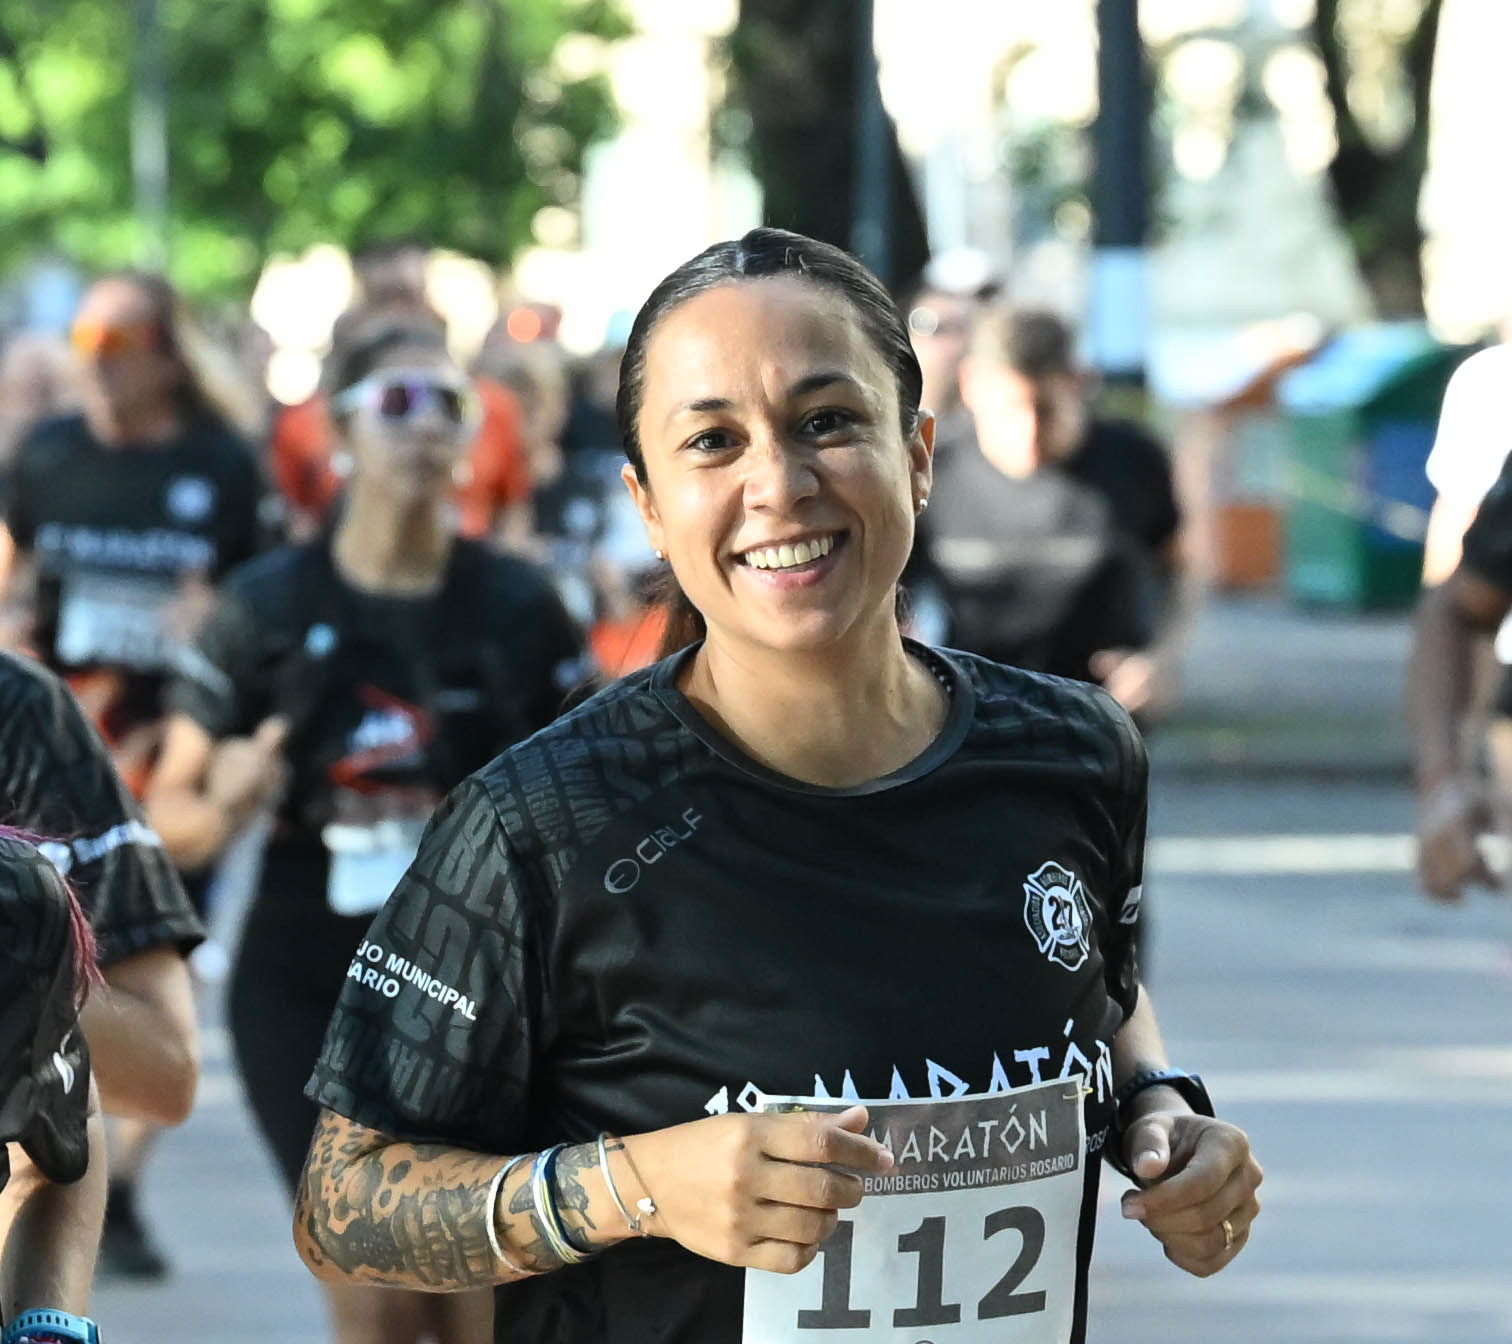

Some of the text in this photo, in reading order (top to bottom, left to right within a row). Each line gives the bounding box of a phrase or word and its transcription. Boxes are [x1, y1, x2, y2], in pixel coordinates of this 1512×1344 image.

[347, 959, 401, 999] ARIO
[384, 952, 478, 1022] MUNICIPAL
[868, 1103, 1050, 1166] MARATÓN
[864, 1153, 1075, 1194] BOMBEROS VOLUNTARIOS ROSARIO
[796, 1205, 1047, 1330] 112
